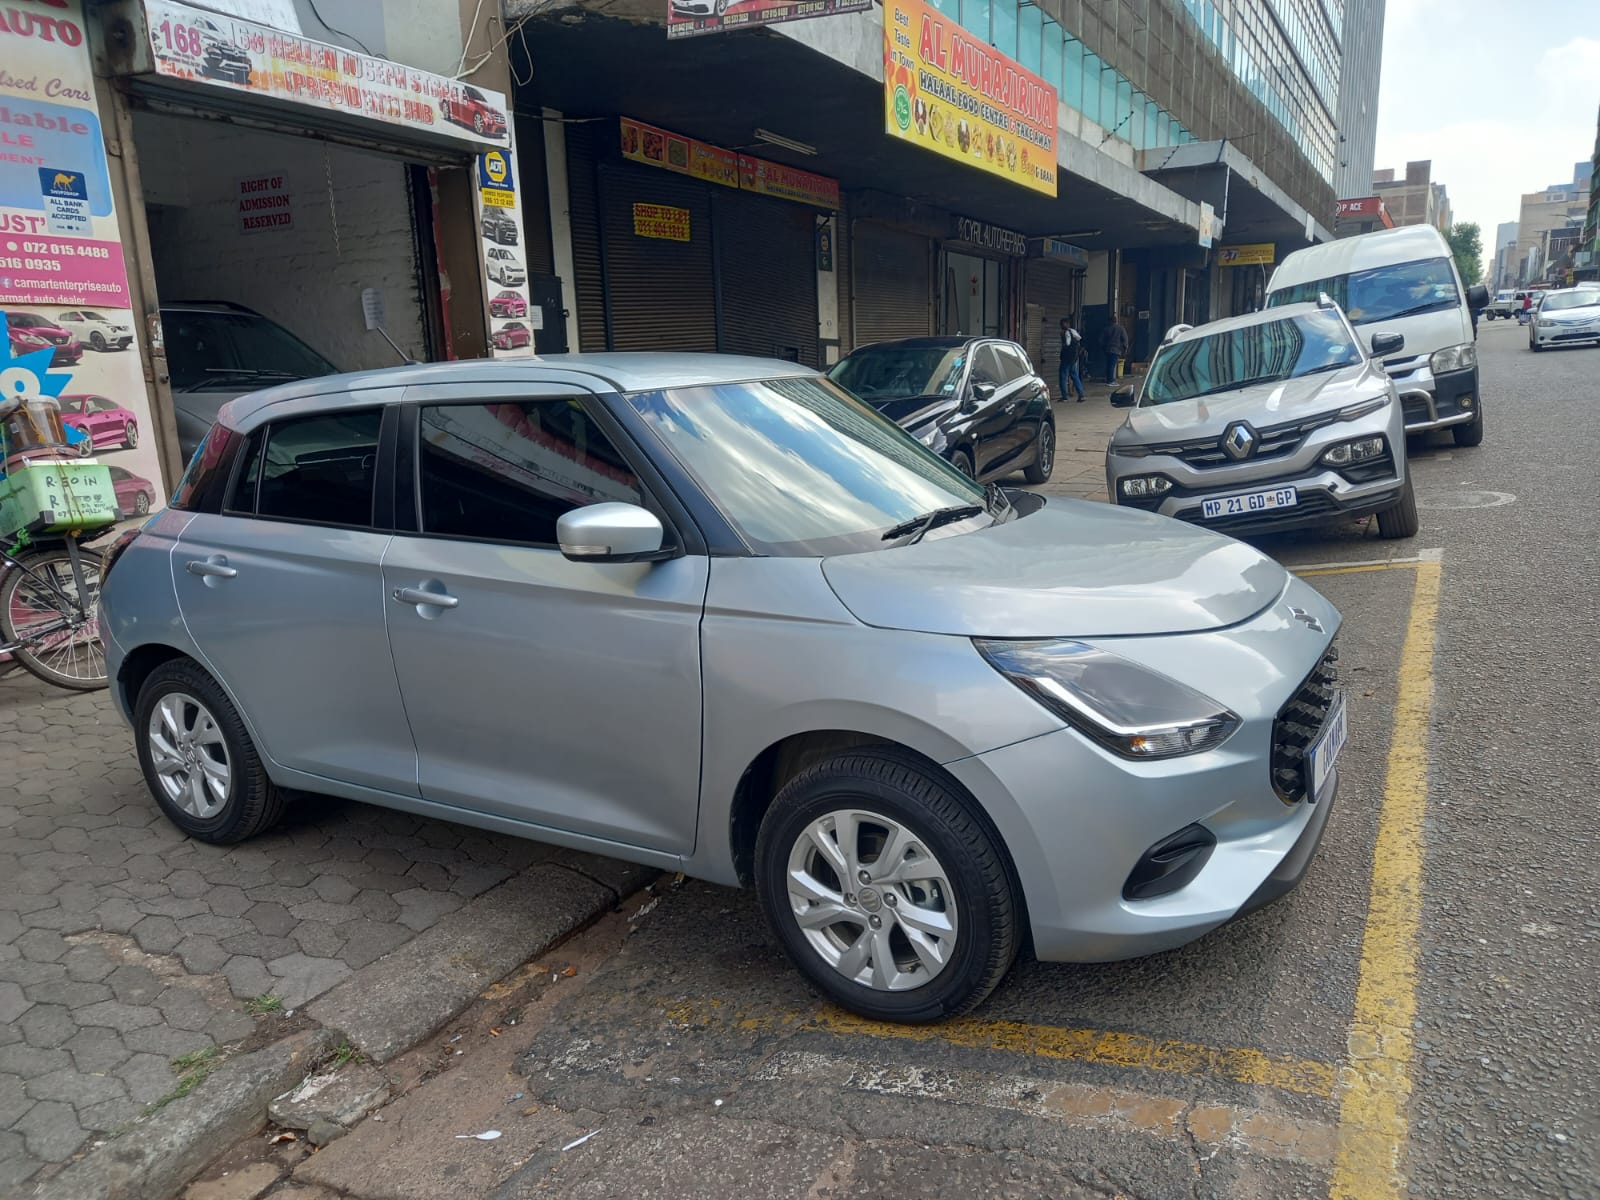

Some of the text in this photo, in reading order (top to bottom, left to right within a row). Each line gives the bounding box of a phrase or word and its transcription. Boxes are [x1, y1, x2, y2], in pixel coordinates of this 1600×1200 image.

[894, 8, 909, 27] Best
[160, 20, 201, 57] 168
[894, 28, 910, 49] Taste
[918, 14, 947, 73] AL
[950, 34, 1053, 129] MUHAJIRINA
[0, 70, 91, 102] sed Cars
[918, 69, 958, 106] HALAAL
[958, 90, 979, 117] FOOD
[980, 103, 1008, 130] CENTRE
[1016, 122, 1033, 143] TAKE
[1034, 131, 1053, 153] AWAY
[240, 176, 284, 194] RIGHT OF
[56, 206, 80, 215] CARDS
[64, 200, 84, 208] BANK
[240, 194, 291, 213] ADMISSION
[51, 213, 87, 222] ACCEPTED
[243, 212, 292, 230] RESERVED
[23, 241, 48, 254] 072
[25, 258, 61, 272] 0935
[14, 278, 122, 293] carmartenterpriseauto
[1205, 489, 1293, 516] MP 21 GD GP
